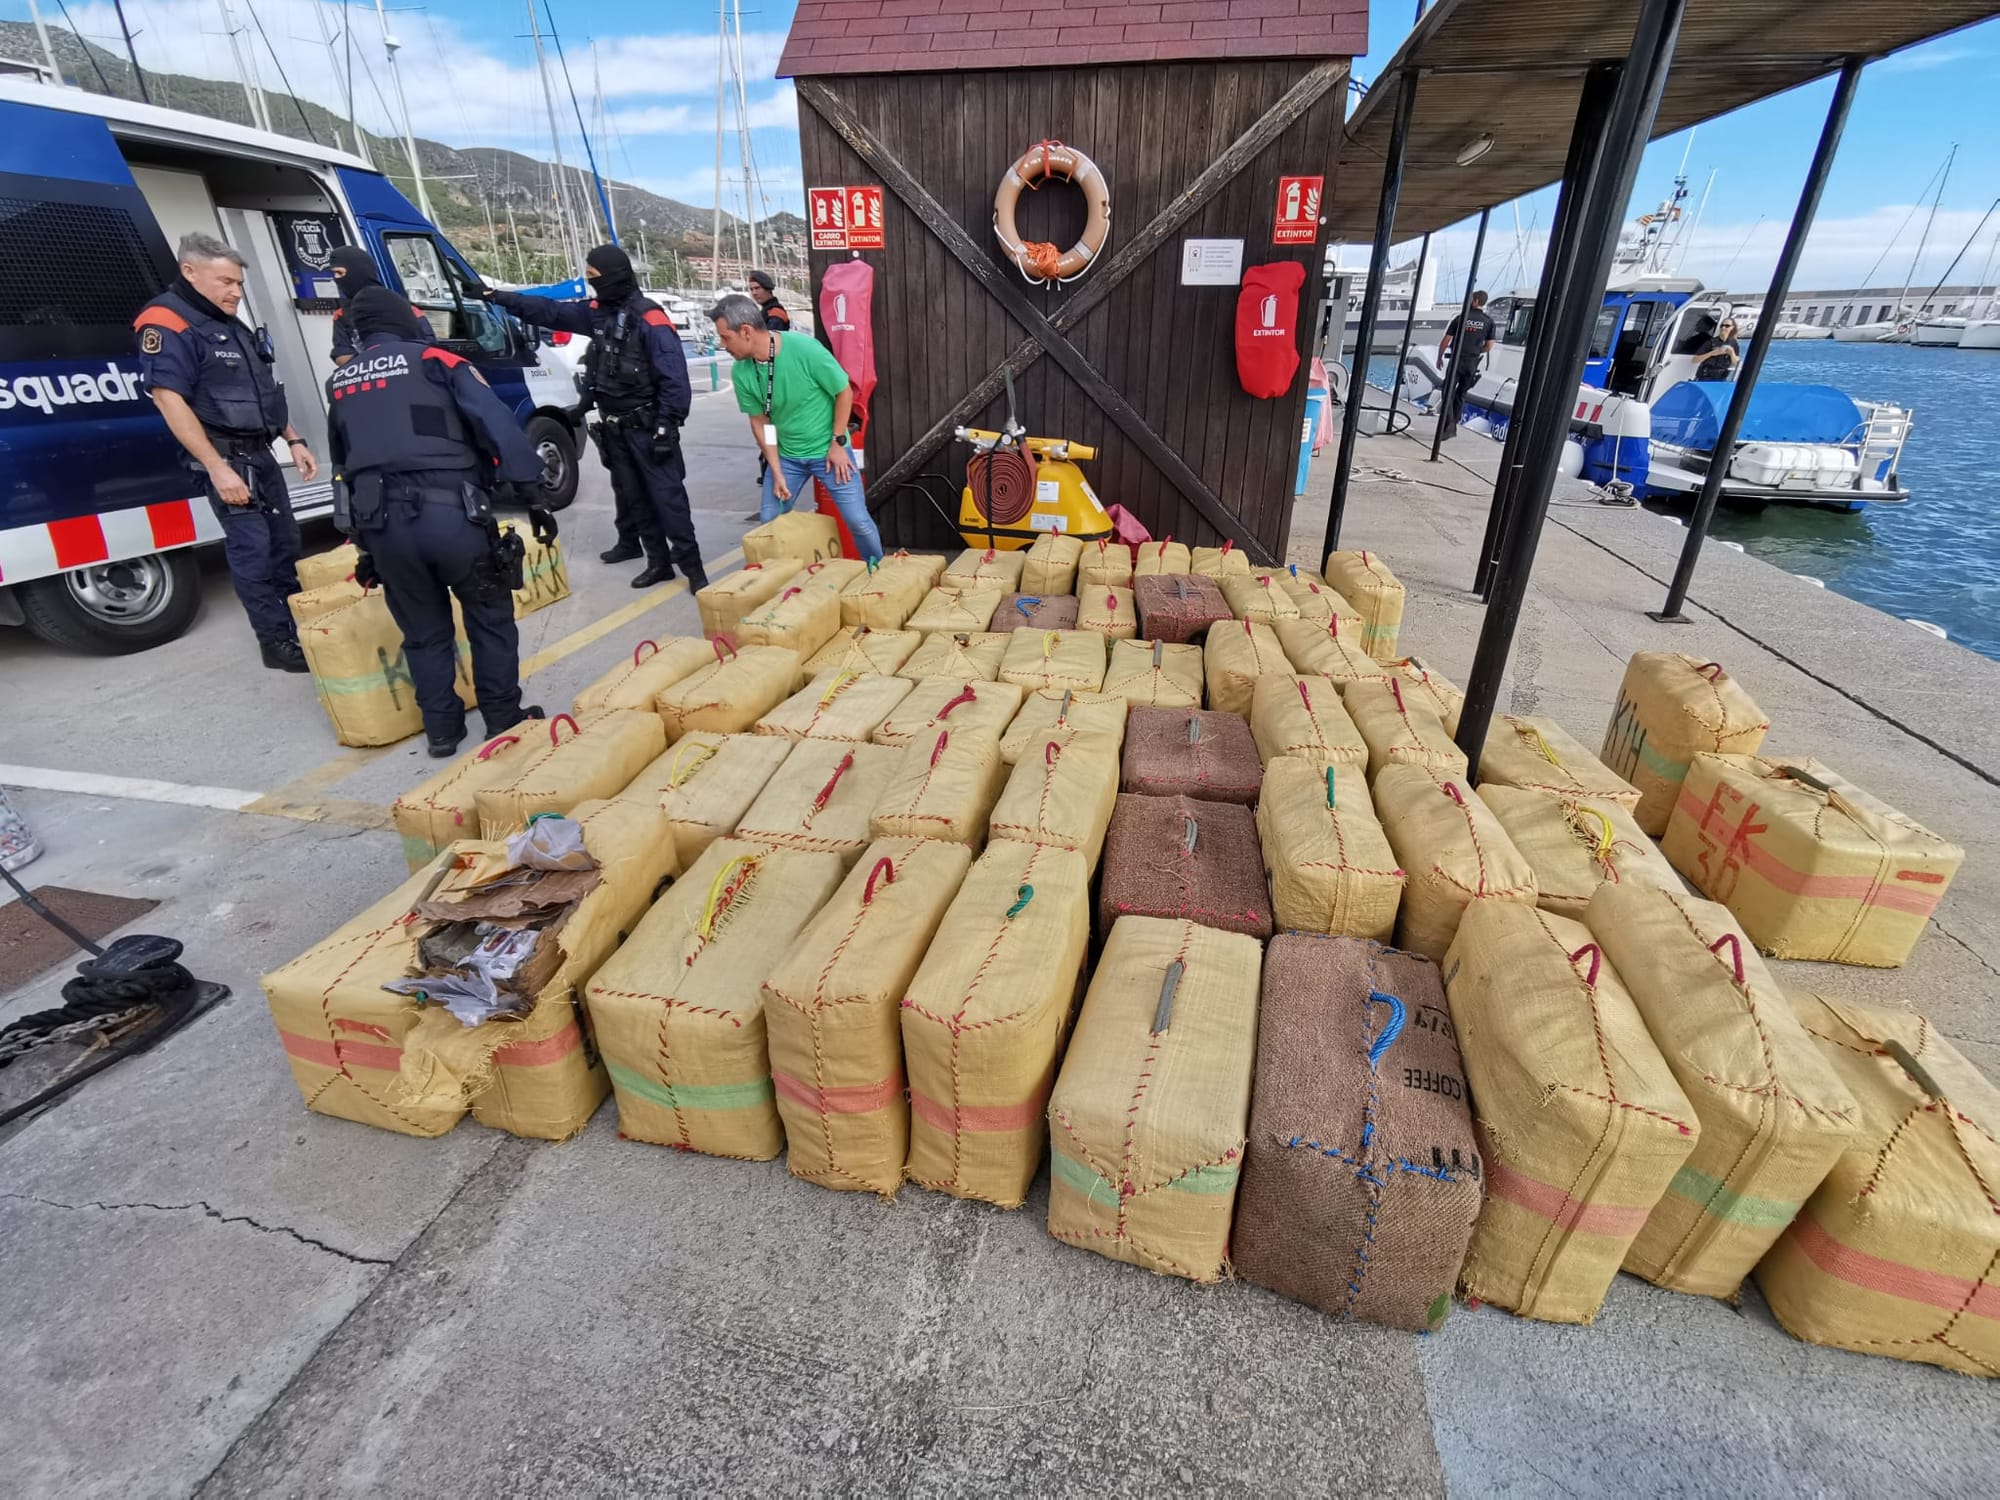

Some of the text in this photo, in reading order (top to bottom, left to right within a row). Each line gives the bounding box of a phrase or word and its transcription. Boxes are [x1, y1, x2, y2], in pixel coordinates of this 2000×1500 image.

[295, 225, 321, 233] POLICIA
[1277, 230, 1313, 238] EXTINTOR
[214, 351, 241, 359] POLICIA
[333, 354, 408, 382] POLICIA
[333, 368, 409, 390] mossos d'esquadra
[0, 362, 153, 414] squadr
[1404, 1068, 1462, 1101] COFFEE
